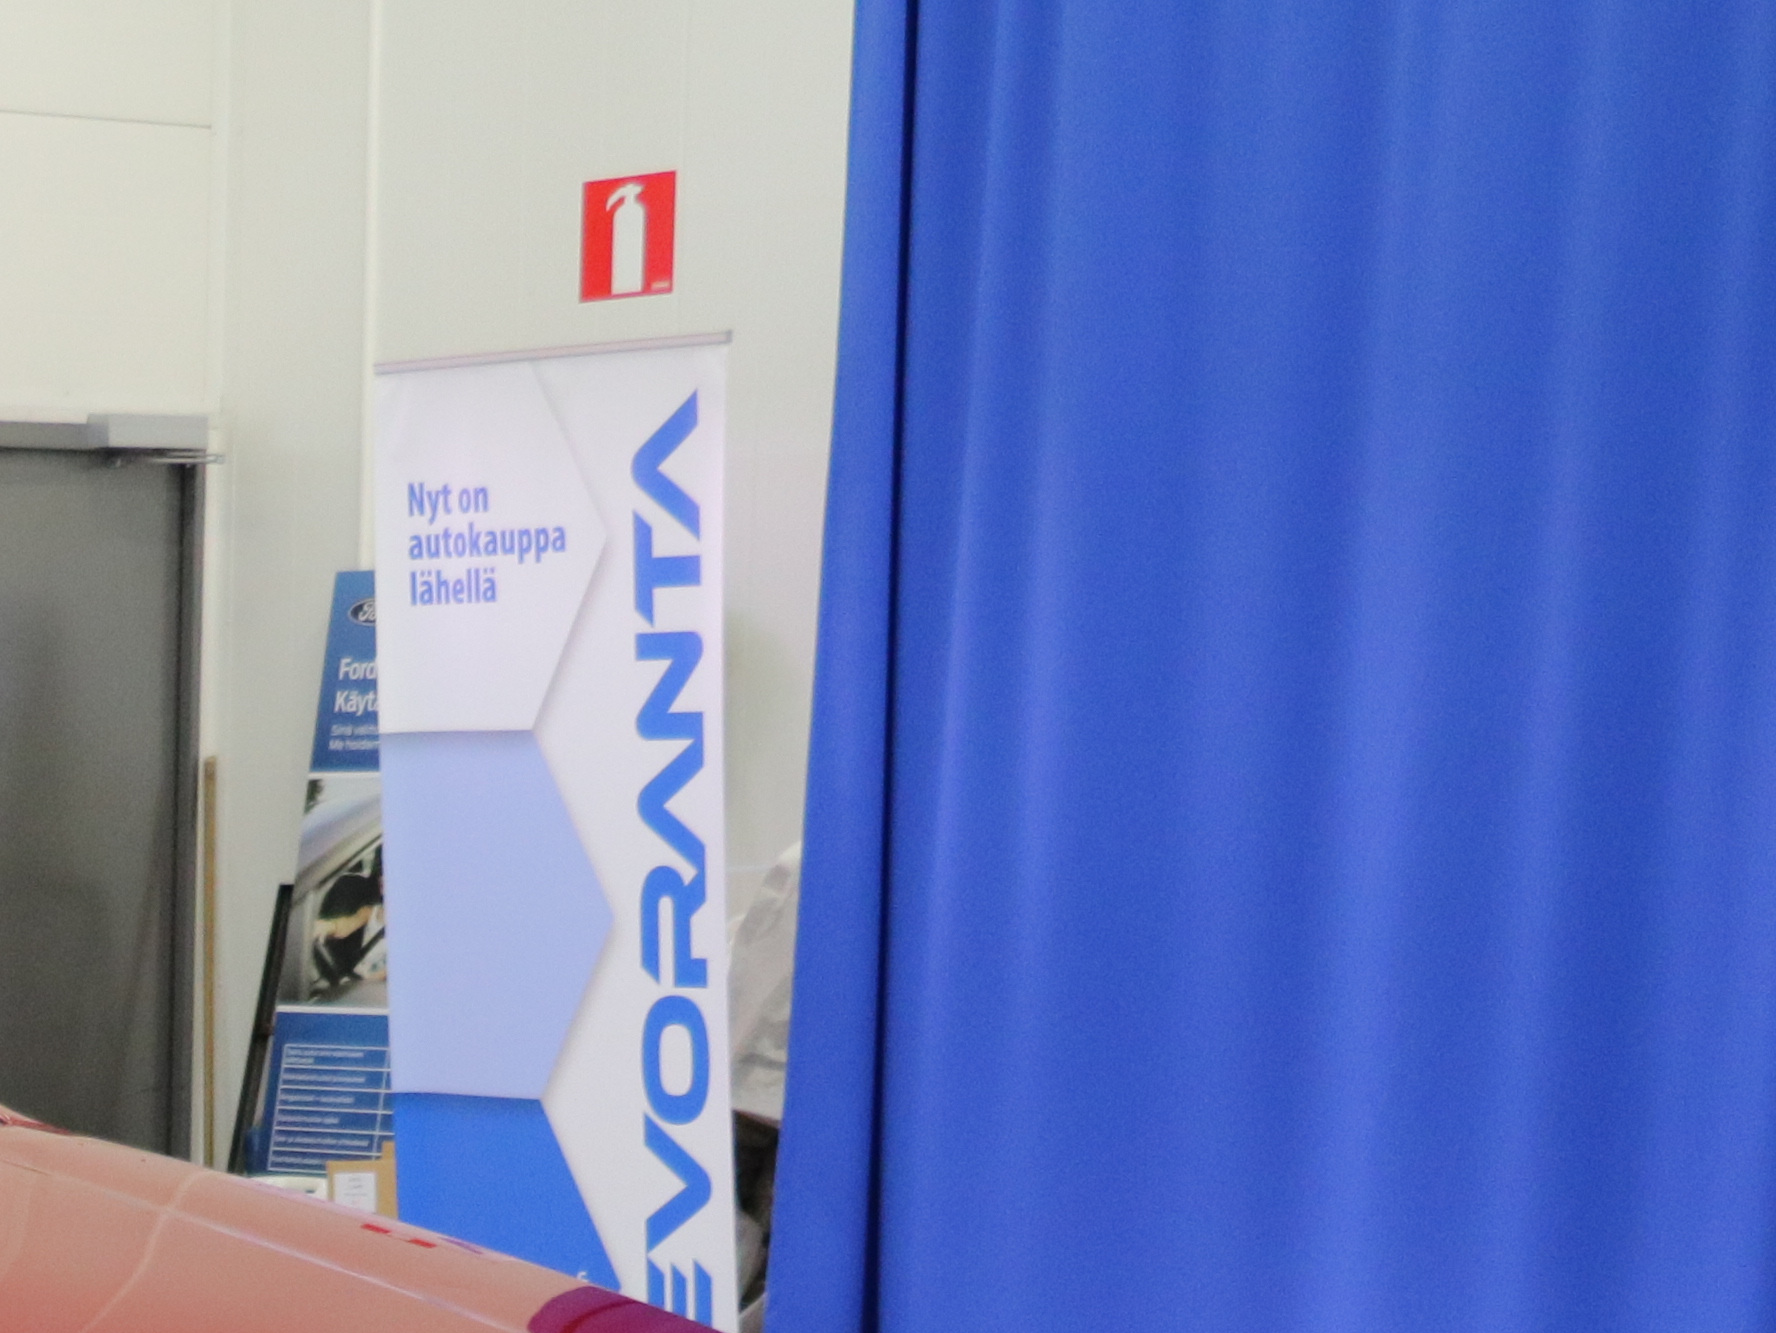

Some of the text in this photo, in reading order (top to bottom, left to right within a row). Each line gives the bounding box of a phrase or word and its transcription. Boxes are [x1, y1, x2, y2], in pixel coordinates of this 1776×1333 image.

[407, 482, 489, 525] Nyt on
[409, 521, 566, 564] autokauppa
[410, 567, 497, 606] lähellä
[334, 689, 380, 716] Käyt
